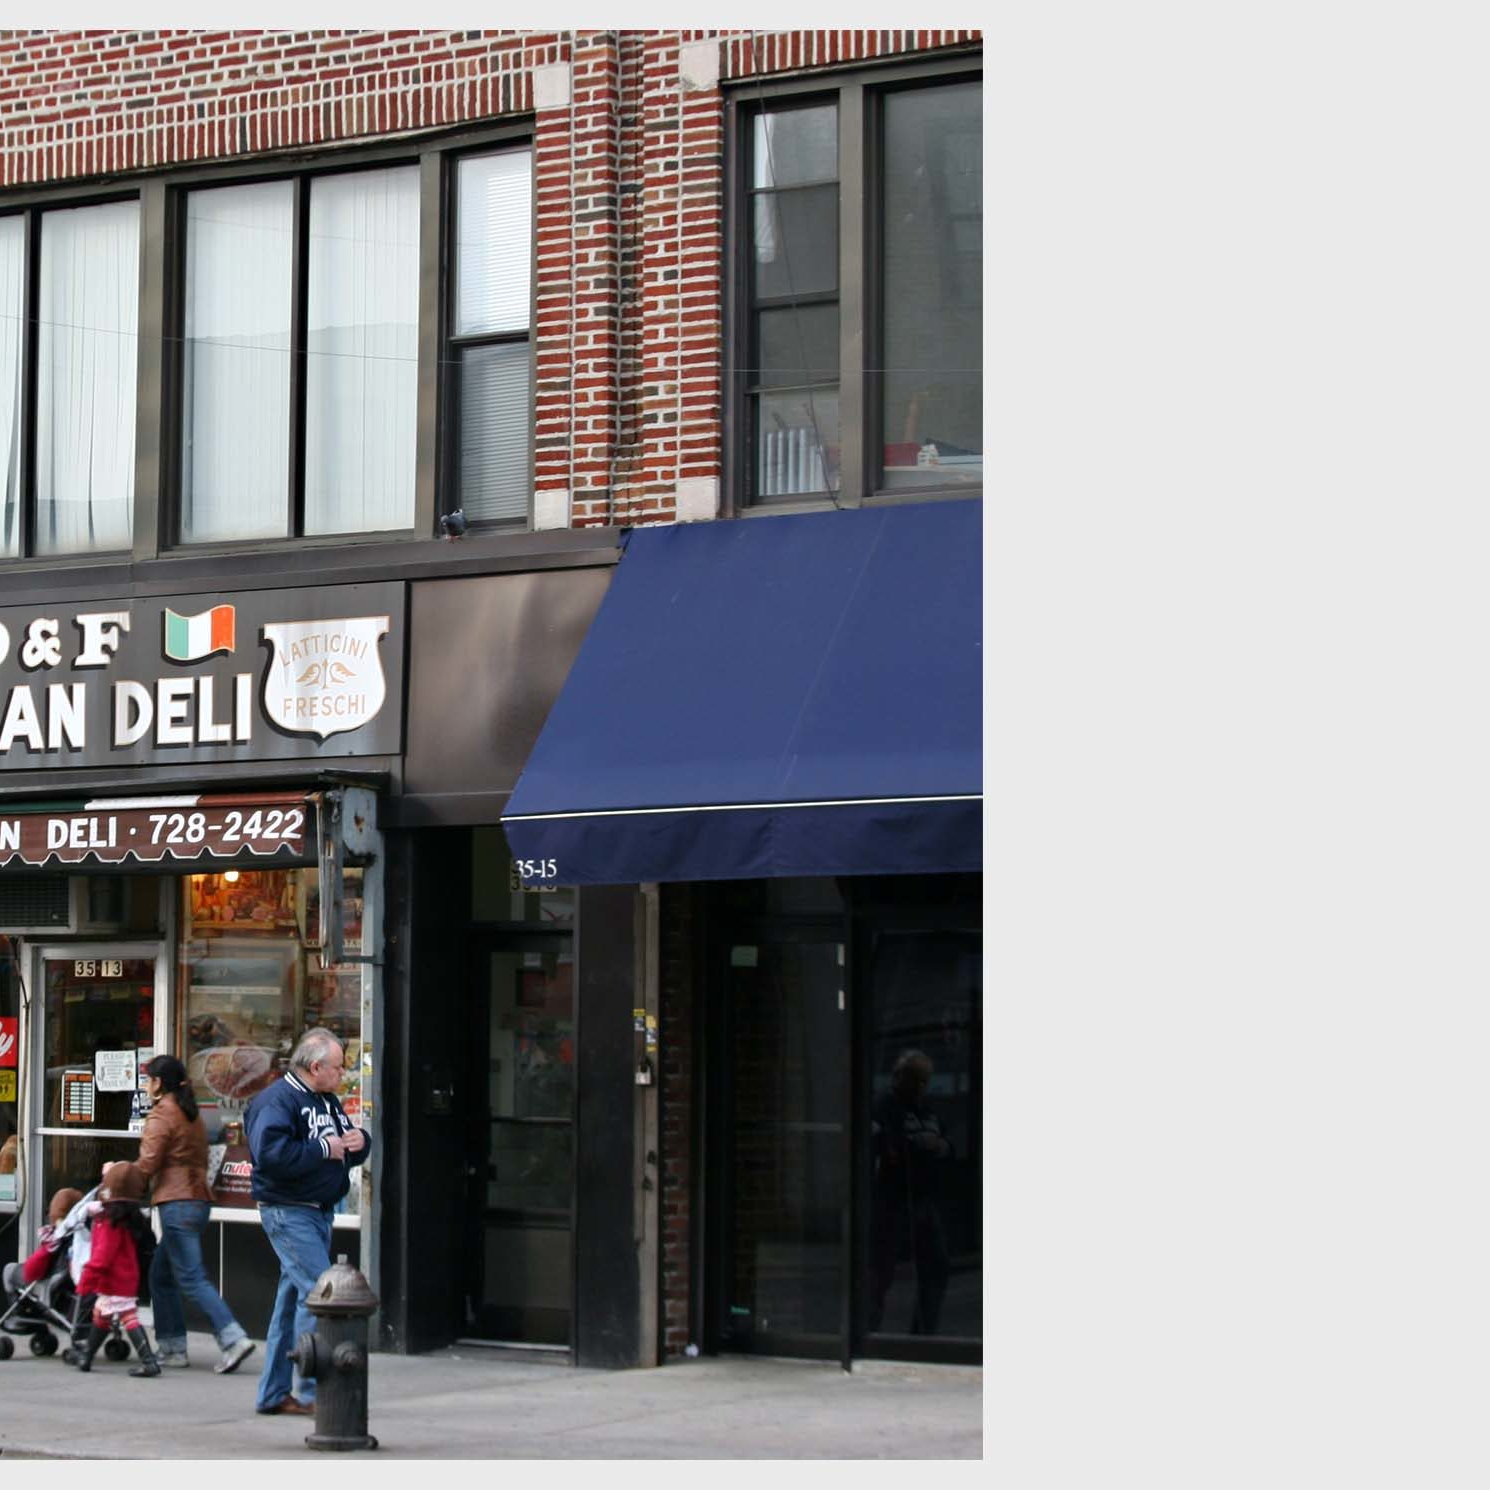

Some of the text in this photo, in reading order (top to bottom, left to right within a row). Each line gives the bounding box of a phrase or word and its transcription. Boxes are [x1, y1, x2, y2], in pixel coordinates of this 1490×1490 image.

[279, 633, 368, 666] LATTICINI
[114, 673, 252, 746] DELI
[283, 694, 366, 718] FRESCHI
[47, 816, 117, 850] DELI
[149, 808, 304, 845] 728-2422
[515, 858, 557, 878] 35-15
